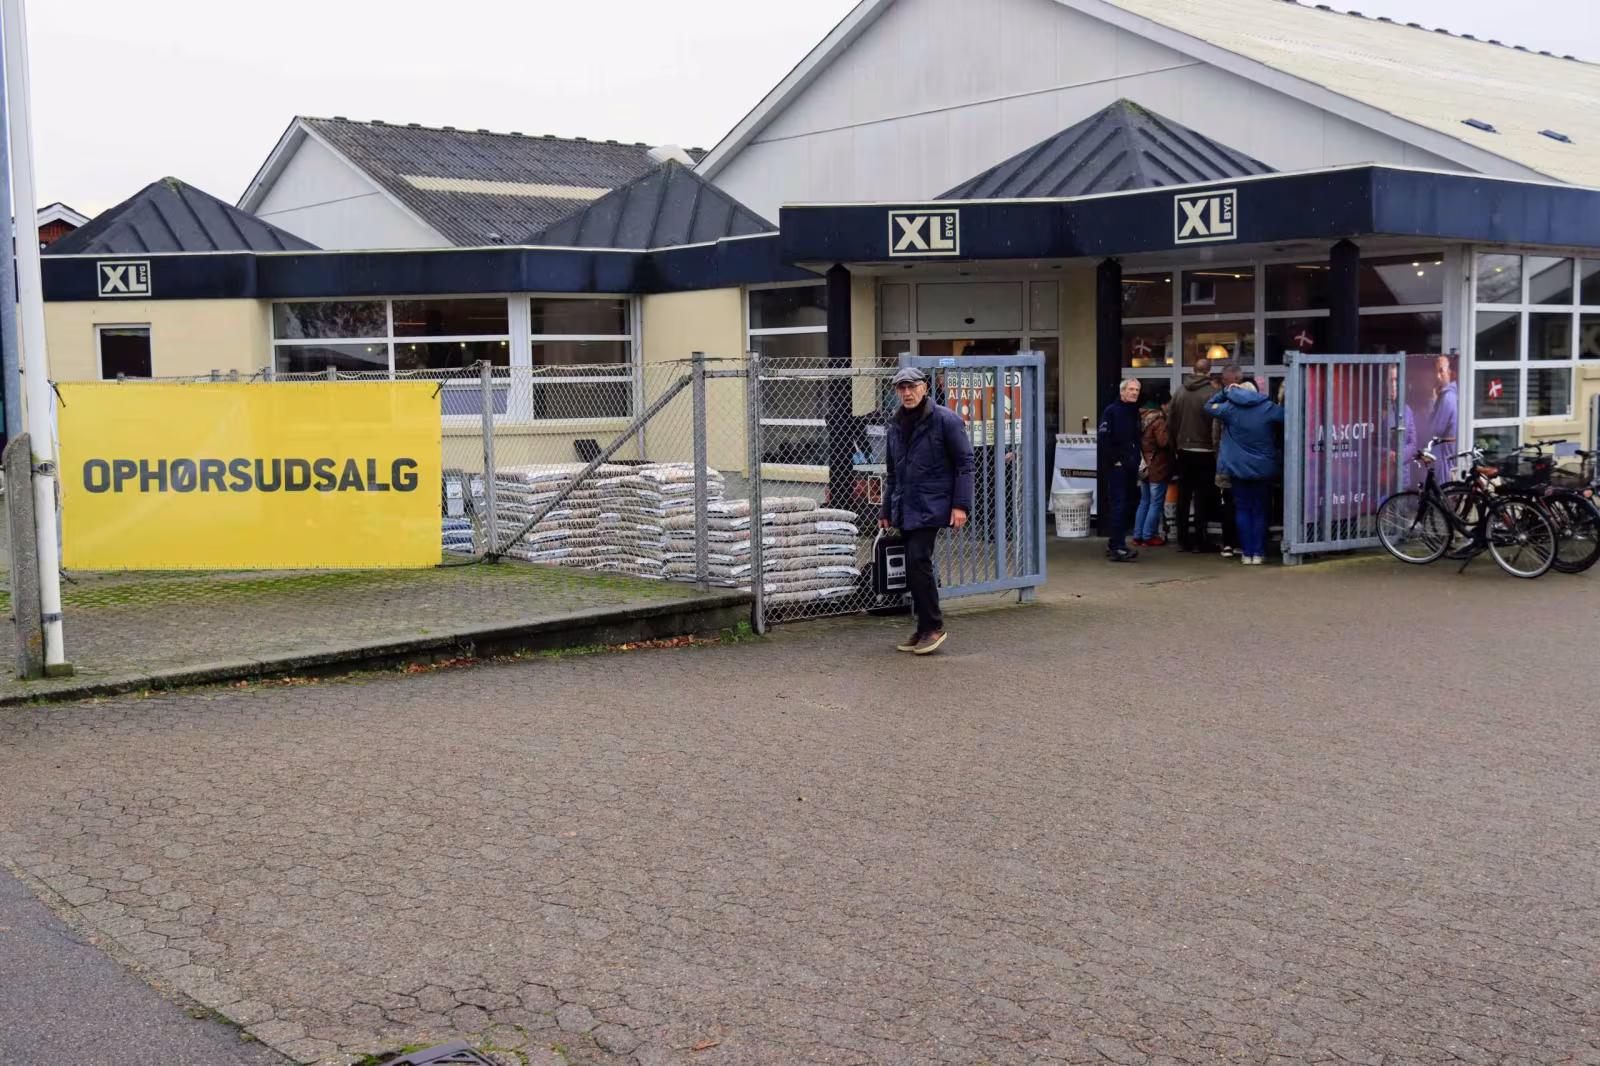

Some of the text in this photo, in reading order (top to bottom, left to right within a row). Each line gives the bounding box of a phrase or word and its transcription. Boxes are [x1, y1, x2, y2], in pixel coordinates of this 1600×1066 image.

[1179, 197, 1232, 237] XL
[1223, 196, 1232, 220] BYG
[894, 215, 954, 250] XL
[945, 216, 954, 237] BYG
[102, 265, 147, 292] XL
[139, 265, 147, 282] BYG
[83, 458, 418, 493] OPHØRSUDSALG
